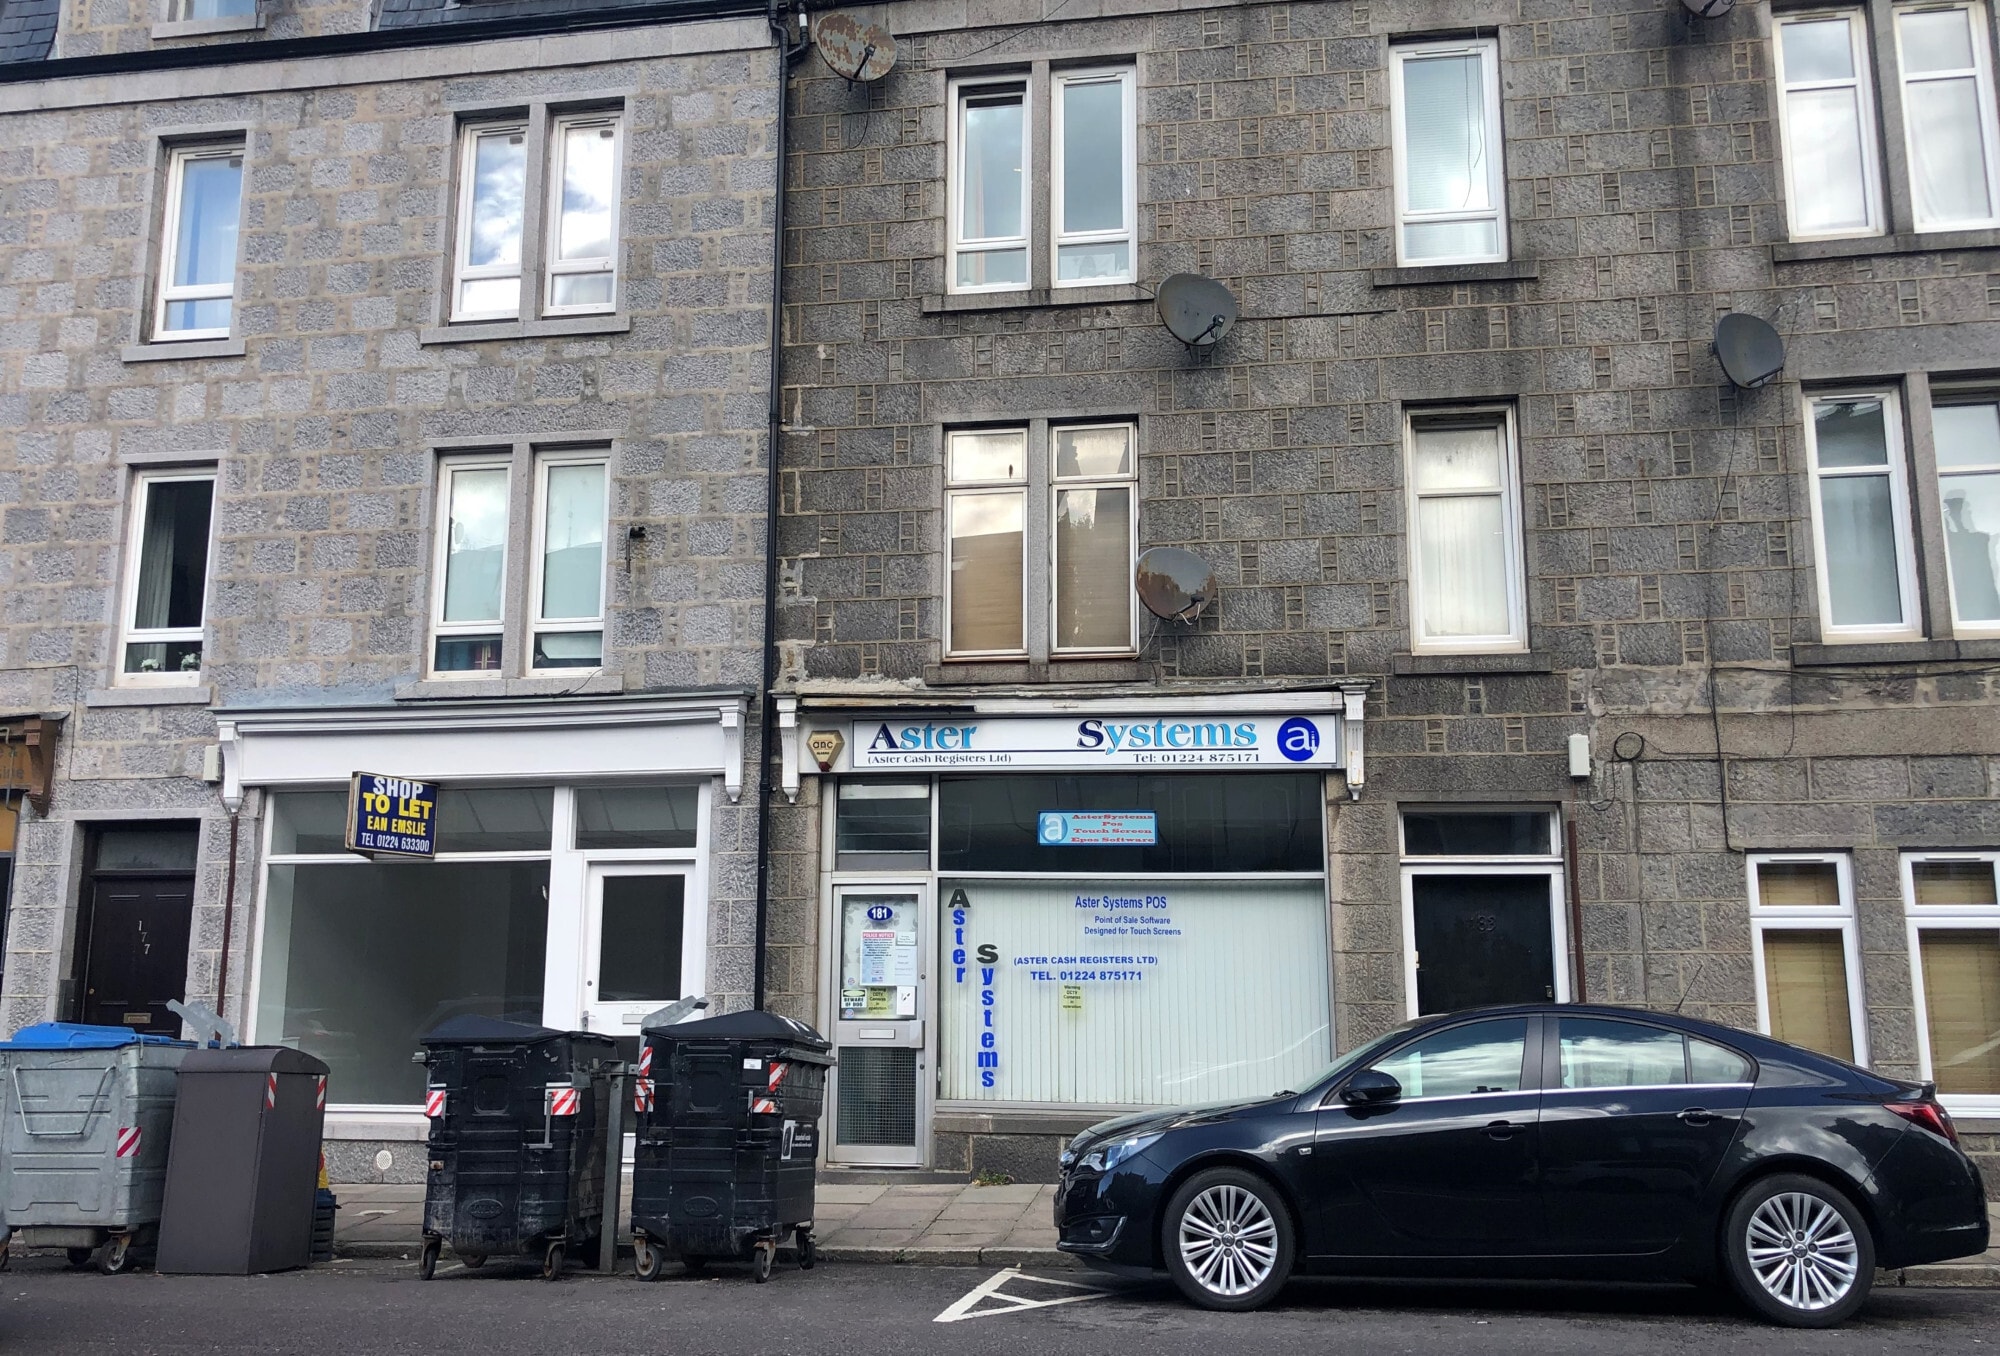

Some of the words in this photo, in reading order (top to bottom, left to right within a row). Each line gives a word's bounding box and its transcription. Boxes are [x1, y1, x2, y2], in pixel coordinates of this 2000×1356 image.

[868, 721, 978, 750] Aster
[1077, 718, 1258, 755] Systems
[868, 754, 900, 765] (Aster
[905, 754, 931, 764] Cash
[935, 753, 986, 764] Registers
[989, 752, 1012, 763] Ltd)
[1133, 753, 1156, 763] Tel:
[1161, 753, 1204, 763] 01224
[1209, 753, 1259, 762] 875171
[373, 776, 423, 800] SHOP
[363, 792, 390, 814] TO
[399, 797, 433, 819] LET
[367, 815, 388, 831] EAN
[391, 818, 426, 836] EMSLIE
[361, 832, 374, 846] TEL
[377, 834, 399, 848] 01224
[401, 837, 430, 852] 633300
[1075, 895, 1100, 909] Aster
[1102, 895, 1143, 911] Systems
[1146, 896, 1167, 909] POS
[871, 907, 888, 919] 181
[1094, 915, 1113, 924] Point
[1114, 915, 1122, 924] of
[1123, 915, 1138, 924] Sale
[1139, 915, 1171, 925] Software
[1084, 926, 1117, 936] Designed
[1118, 926, 1128, 935] for
[1130, 926, 1151, 935] Touch
[1153, 927, 1182, 936] Screens
[1013, 956, 1048, 966] (ASTER
[1050, 956, 1077, 964] CASH
[1079, 956, 1134, 964] REGISTERS
[1136, 956, 1158, 966] LTD)
[1030, 971, 1056, 981] TEL.
[1060, 971, 1096, 981] 01224
[1099, 971, 1142, 981] 875171
